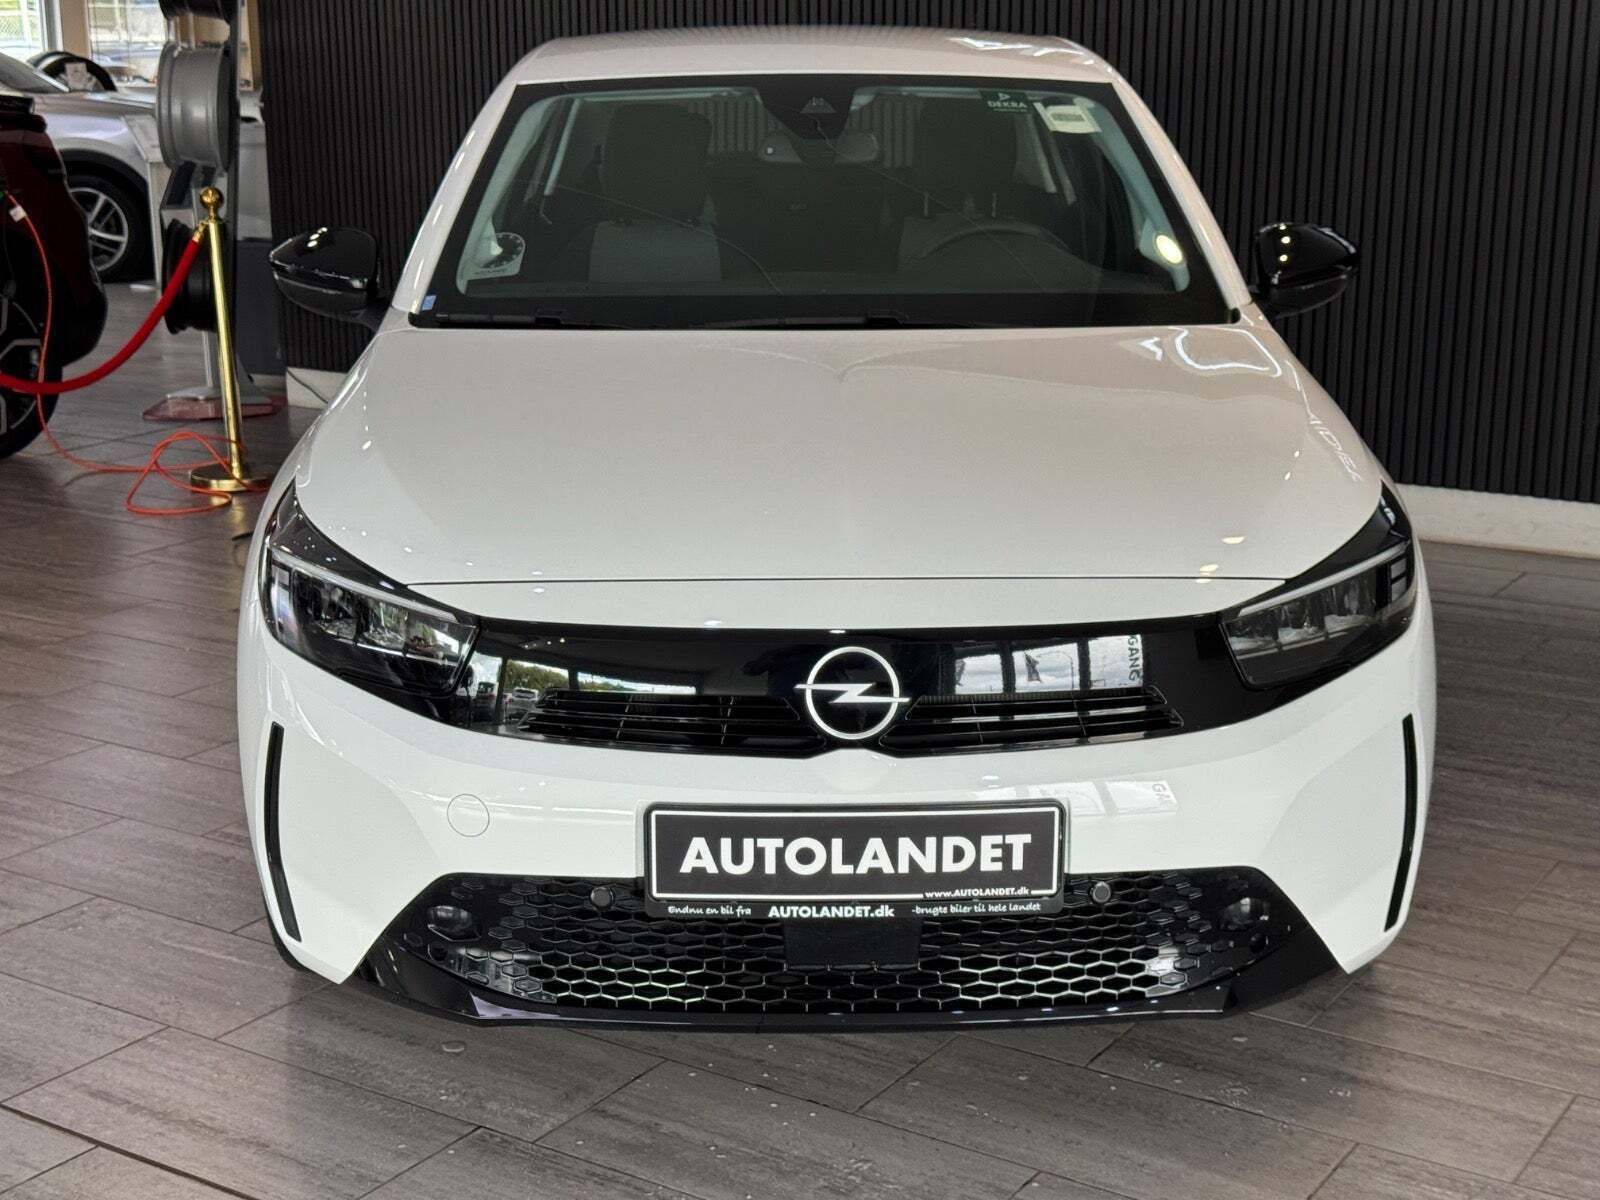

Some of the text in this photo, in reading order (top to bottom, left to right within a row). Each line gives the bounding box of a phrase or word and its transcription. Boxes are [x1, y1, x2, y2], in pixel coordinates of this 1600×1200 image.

[679, 833, 1032, 875] AUTOLANDET
[925, 886, 1029, 898] www.AUTOLANDET.dk
[667, 905, 704, 915] Endnu
[706, 907, 719, 915] en
[720, 904, 734, 915] bil
[736, 905, 751, 917] fra
[768, 904, 895, 918] AUTOLANDET.dk
[950, 903, 972, 914] biler
[974, 903, 986, 912] til
[988, 903, 1008, 912] hele
[1009, 902, 1041, 911] landet
